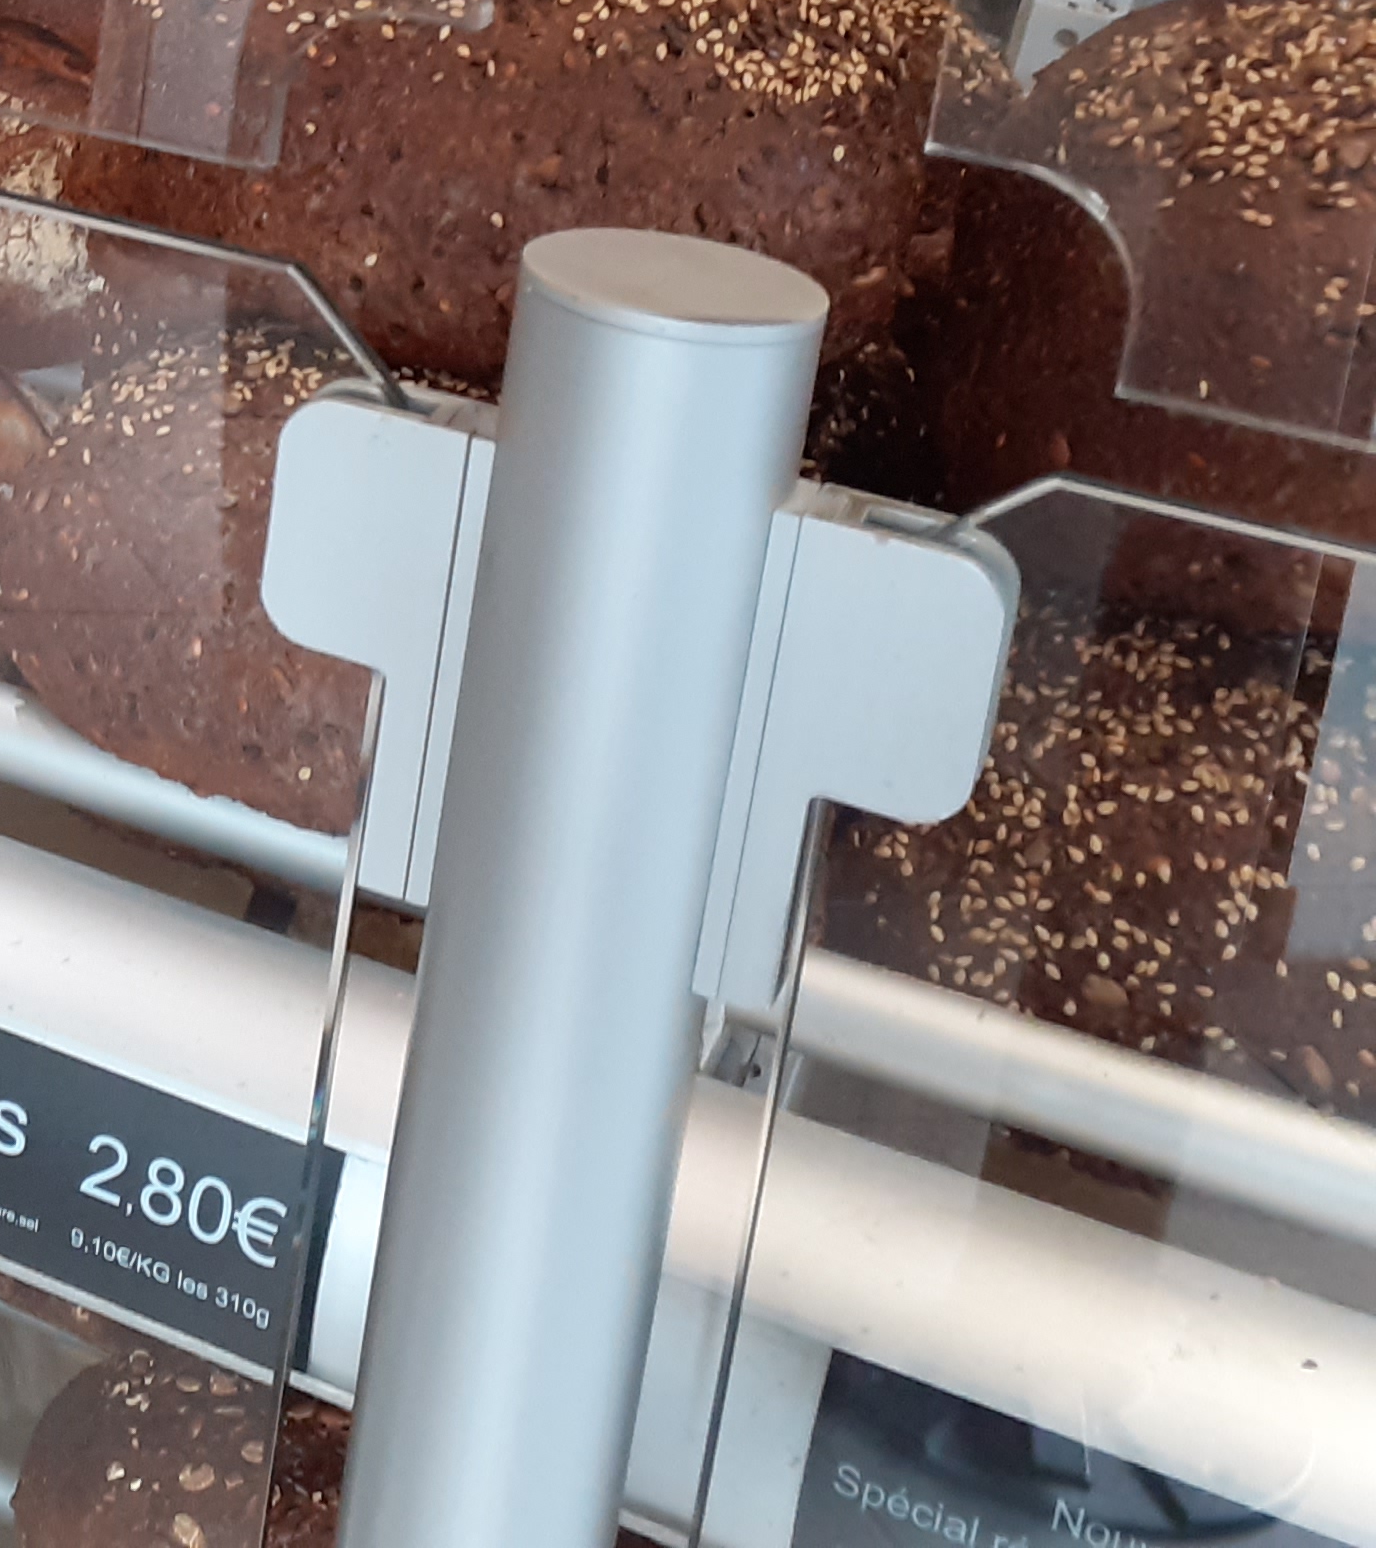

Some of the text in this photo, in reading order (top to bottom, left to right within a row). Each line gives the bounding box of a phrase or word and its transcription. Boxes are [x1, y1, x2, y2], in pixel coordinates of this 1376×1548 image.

[79, 1134, 287, 1268] 2,80€
[177, 1269, 208, 1301] les
[215, 1286, 270, 1330] 310g
[832, 1464, 980, 1548] Spécial
